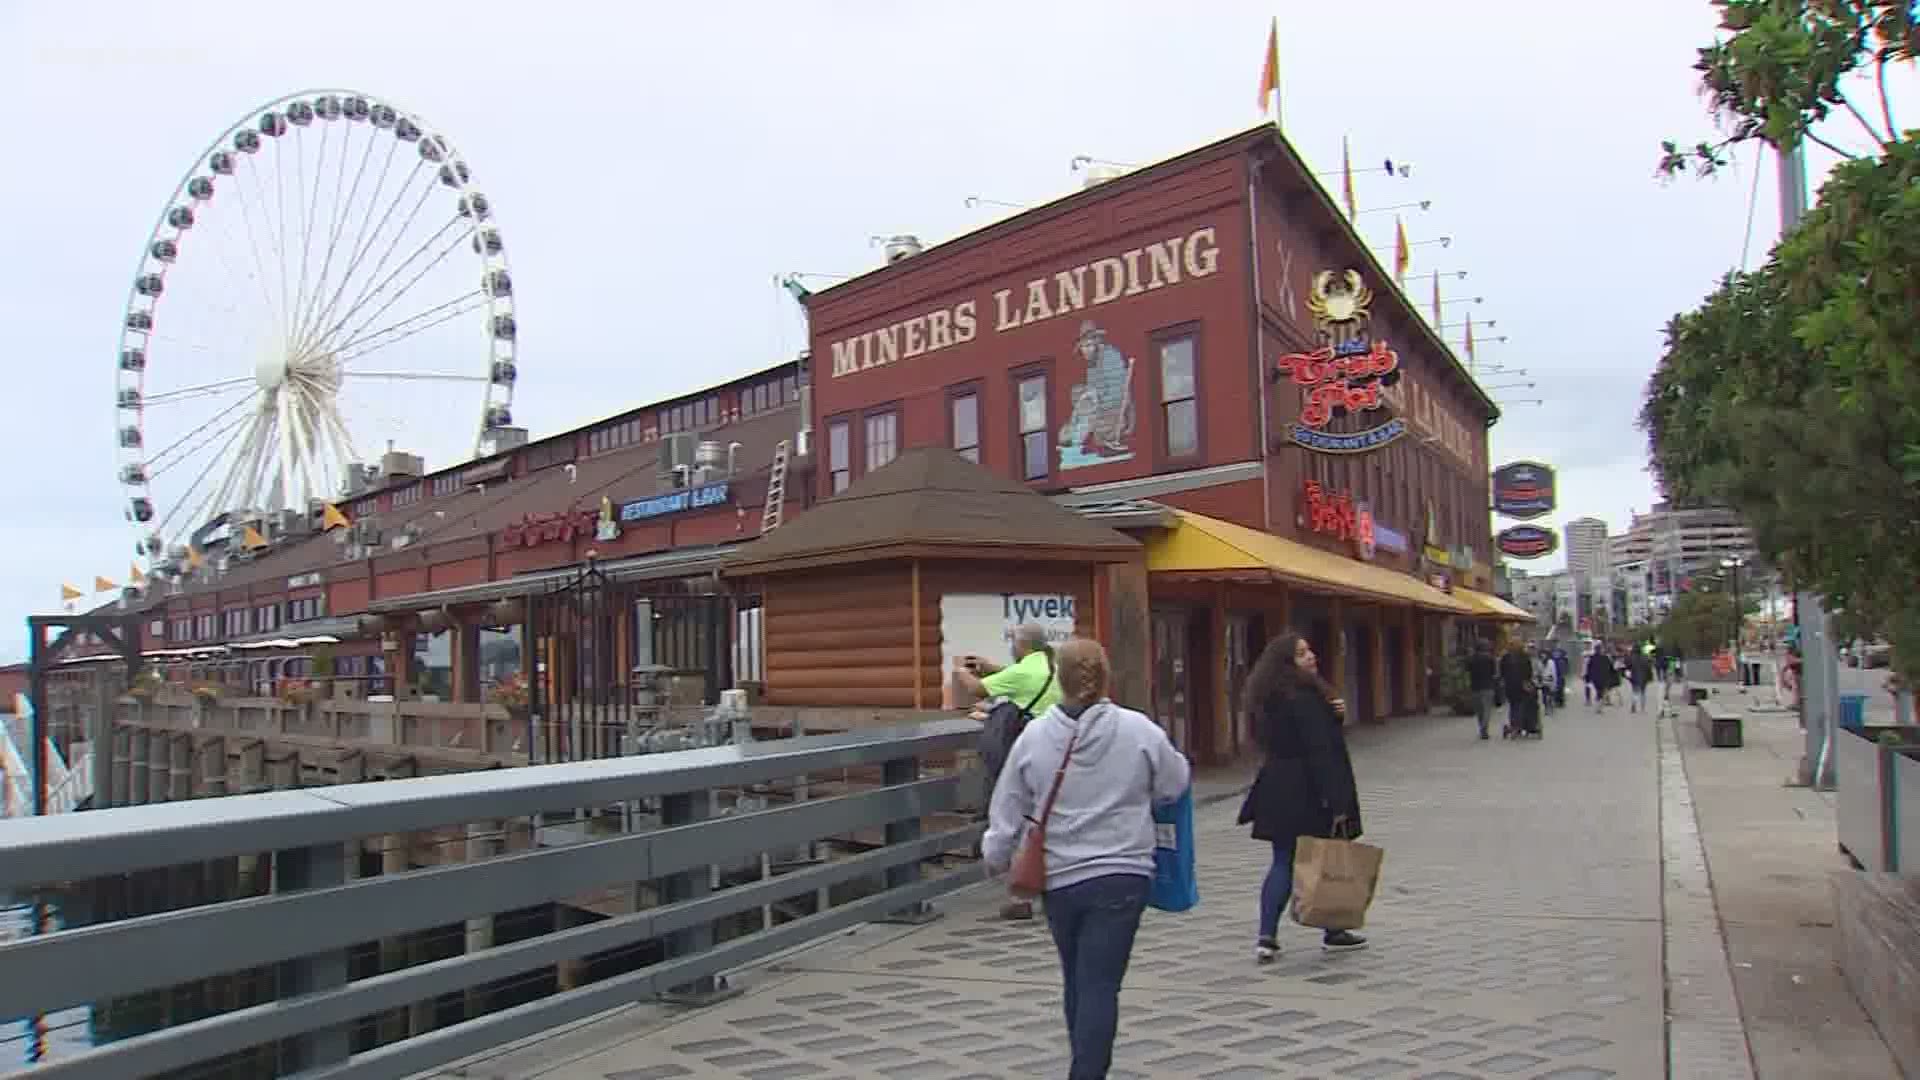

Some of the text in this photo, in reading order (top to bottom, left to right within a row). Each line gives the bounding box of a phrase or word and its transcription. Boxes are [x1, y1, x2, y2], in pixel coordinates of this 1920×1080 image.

[830, 226, 1221, 379] MINERS LANDING
[1001, 591, 1073, 624] Tyvek
